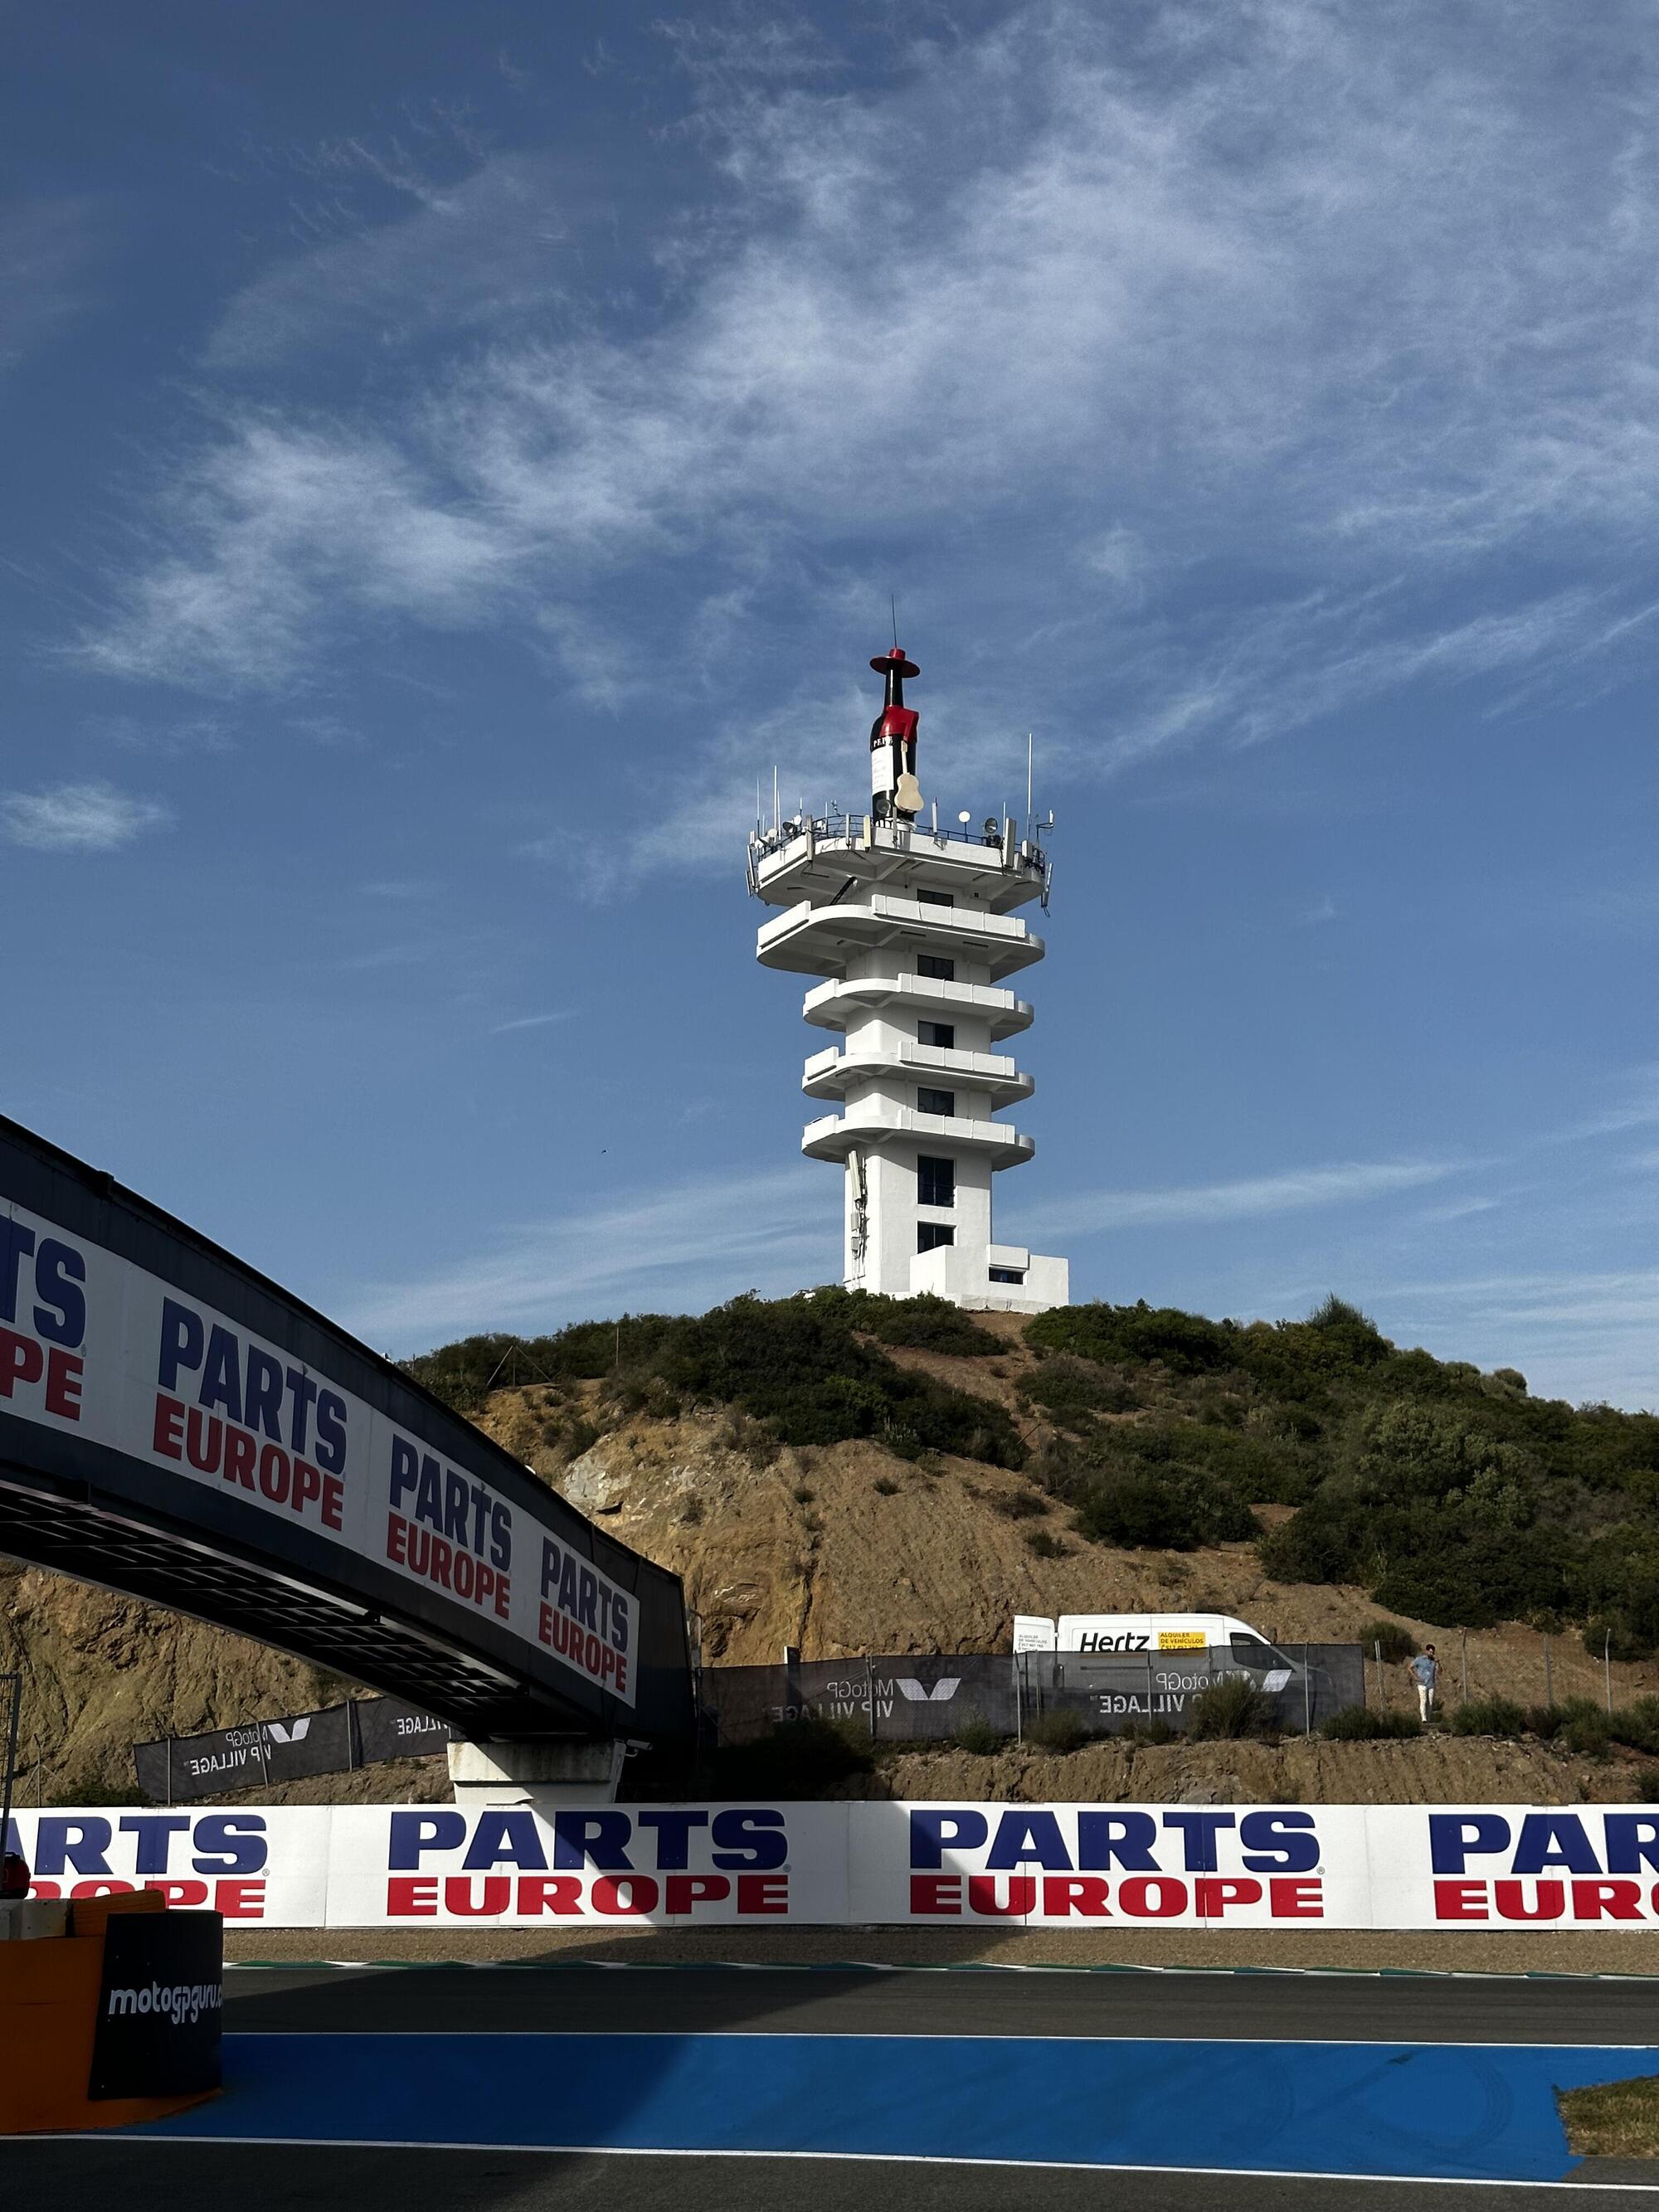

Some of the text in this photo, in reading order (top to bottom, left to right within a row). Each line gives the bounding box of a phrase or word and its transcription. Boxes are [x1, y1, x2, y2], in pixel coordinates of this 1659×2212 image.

[158, 1297, 347, 1475] PARTS
[153, 1393, 343, 1531] EUROPE
[390, 1434, 512, 1572] PARTS
[387, 1512, 510, 1620] EUROPE
[541, 1537, 628, 1653] PARTS
[539, 1602, 626, 1693] EUROPE
[1080, 1632, 1150, 1652] Hertz
[0, 1815, 268, 1875] RTS
[387, 1809, 789, 1871] PARTS
[910, 1810, 1321, 1873] PARTS
[387, 1874, 789, 1916] EUROPE
[910, 1874, 1325, 1918] EUROPE
[1433, 1879, 1659, 1920] EUR
